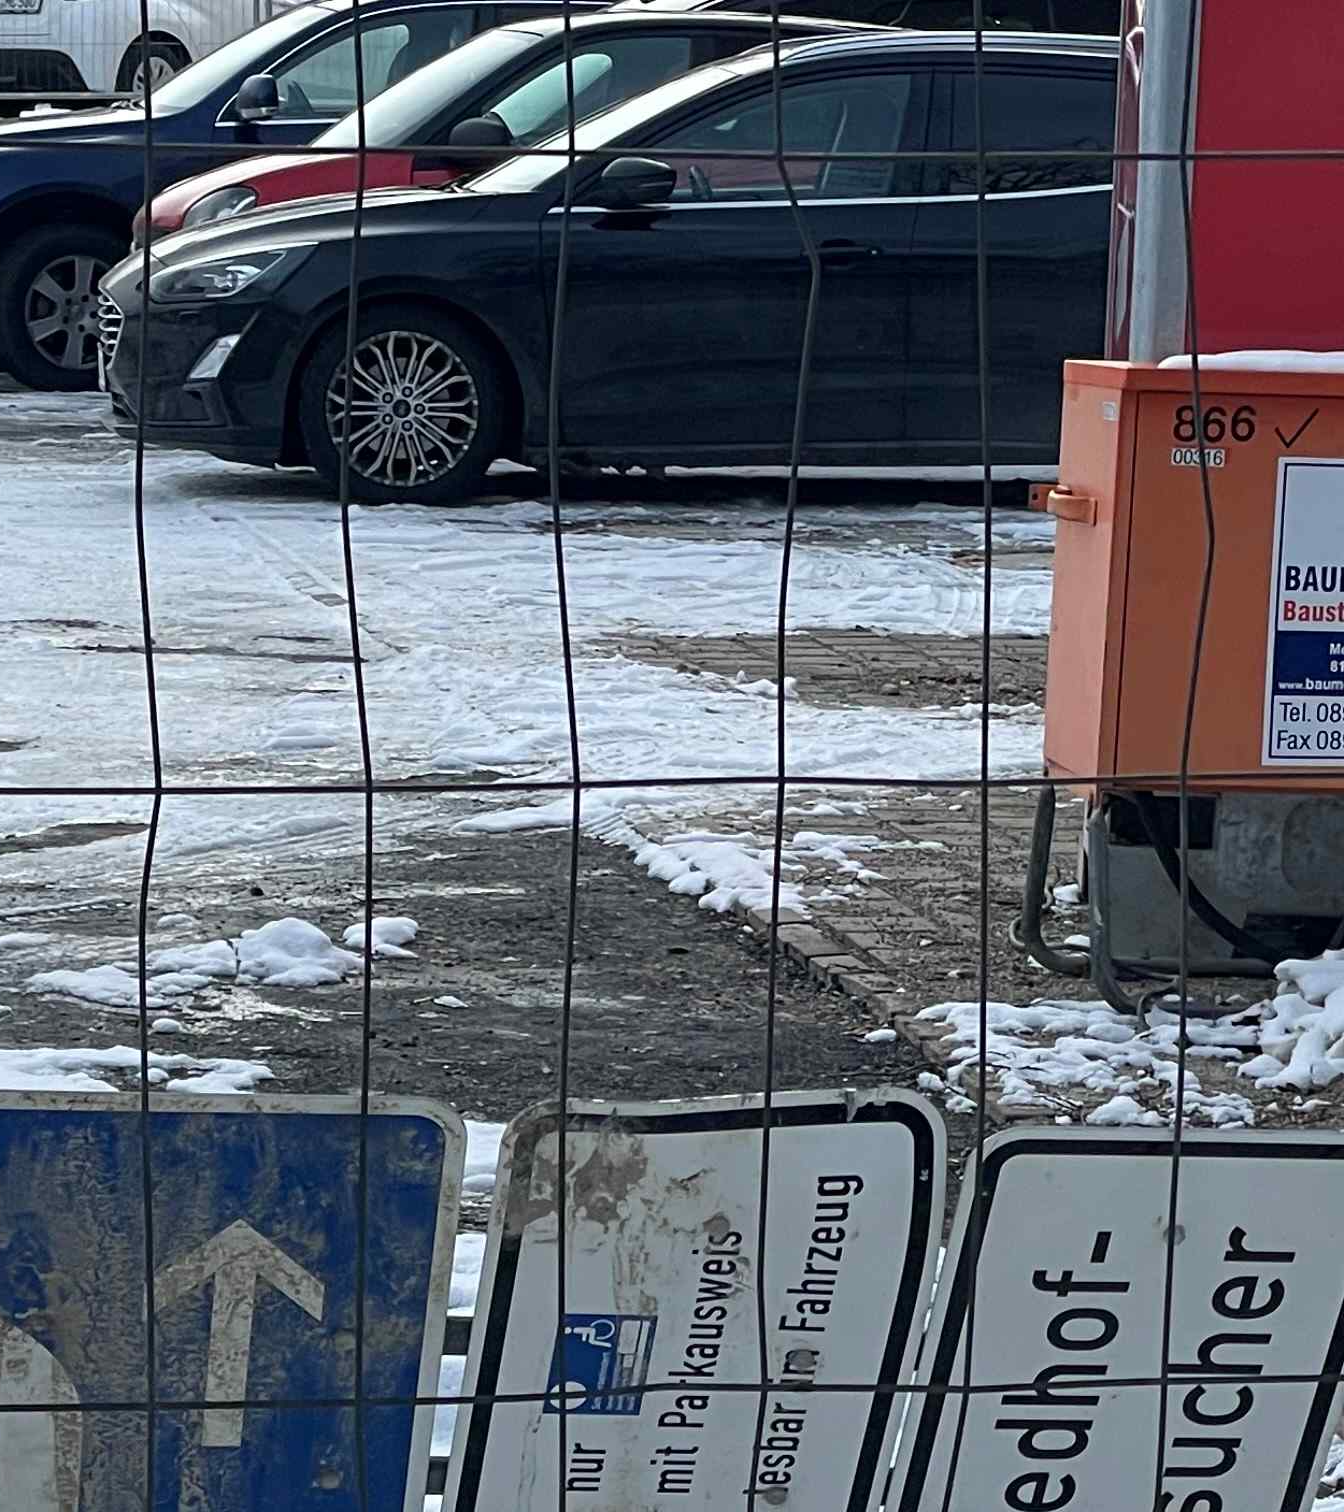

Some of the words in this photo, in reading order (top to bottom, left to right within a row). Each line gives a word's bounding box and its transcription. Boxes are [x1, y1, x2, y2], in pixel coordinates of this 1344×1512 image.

[1173, 405, 1256, 443] 866
[1279, 702, 1311, 722] Tel.
[1276, 730, 1311, 750] Fax
[777, 1174, 864, 1333] Fahrzeug
[657, 1230, 743, 1429] Pakausweis
[565, 1442, 607, 1493] nur
[650, 1446, 700, 1494] mit
